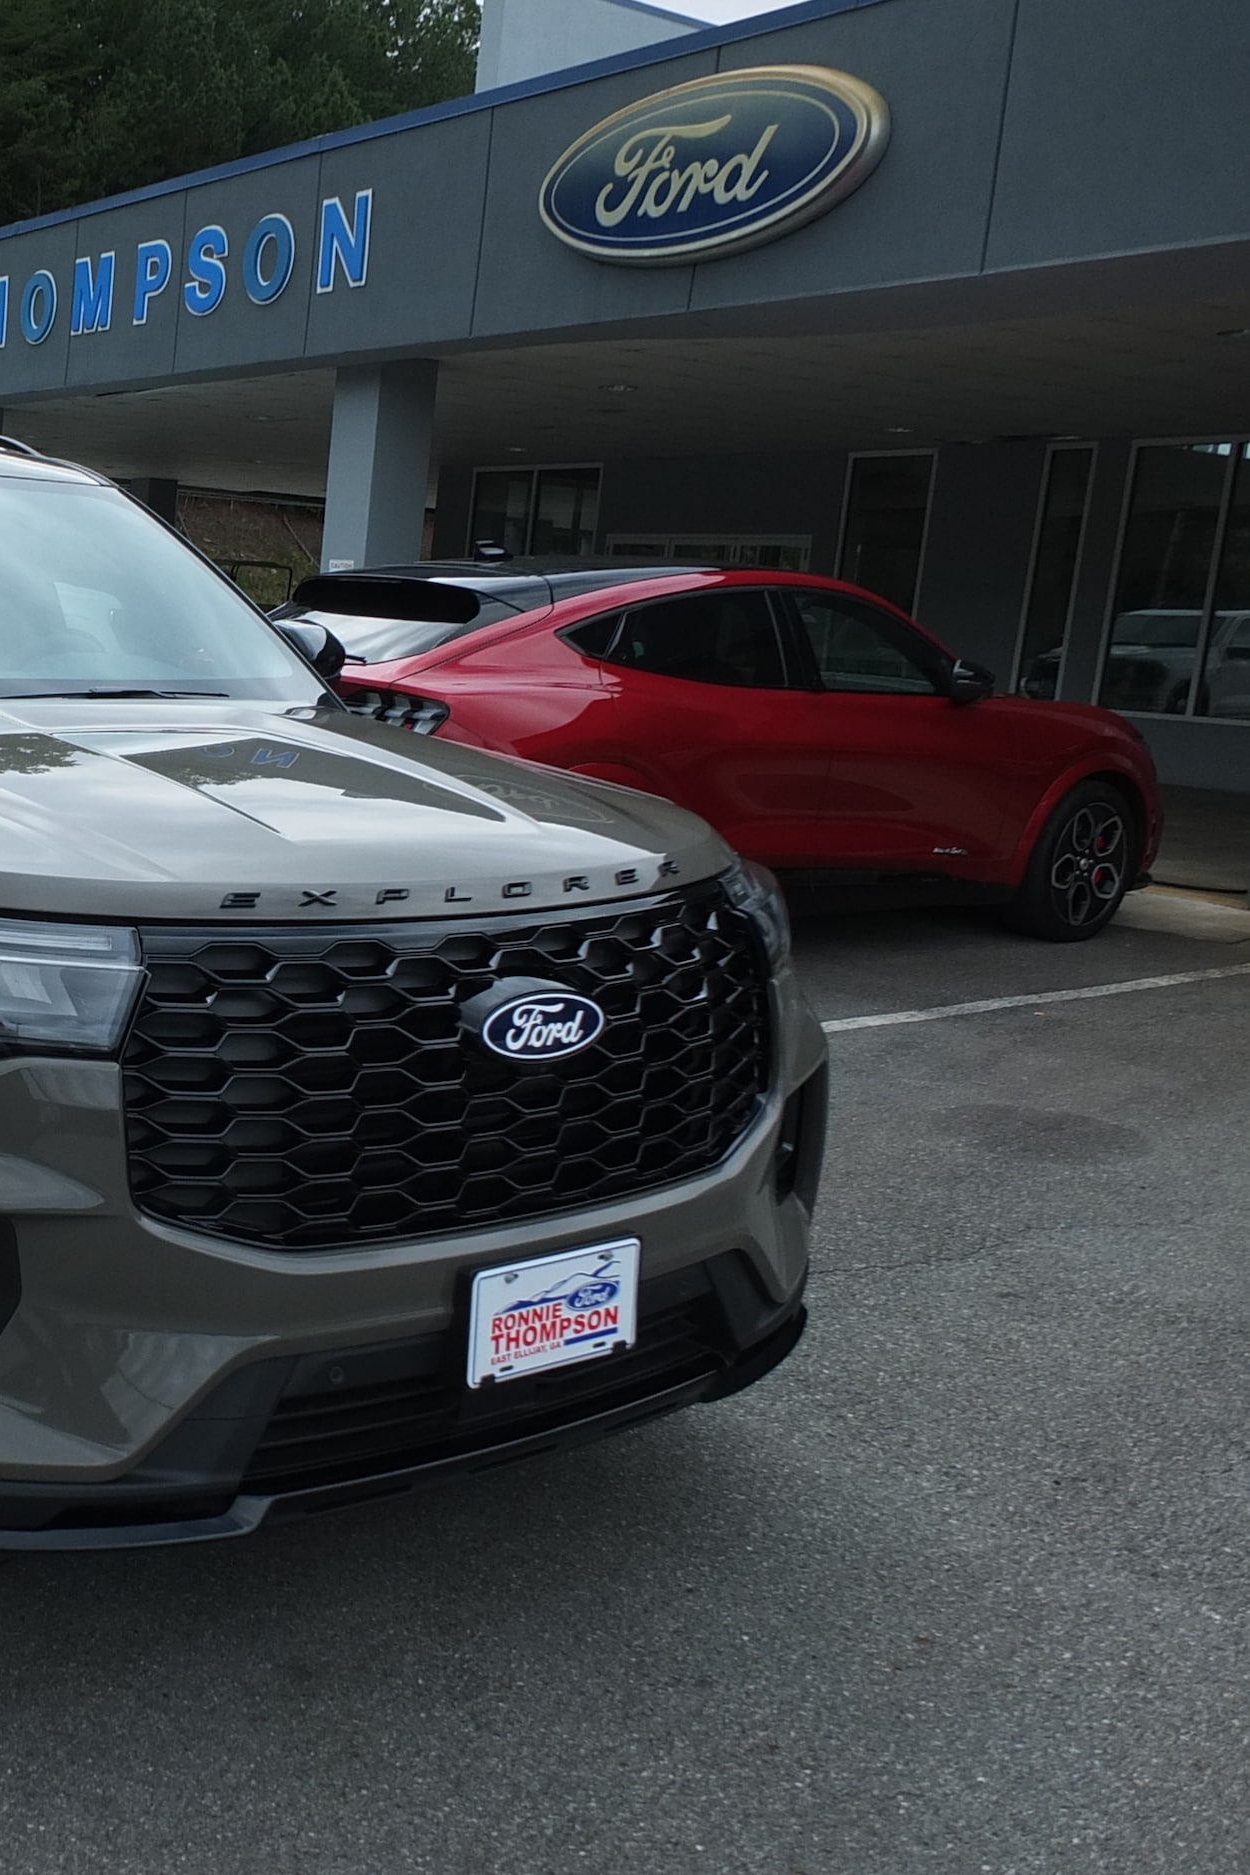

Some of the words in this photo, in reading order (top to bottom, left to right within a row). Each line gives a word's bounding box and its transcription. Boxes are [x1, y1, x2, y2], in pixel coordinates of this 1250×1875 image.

[595, 114, 779, 227] Ford
[219, 858, 682, 909] EXPLORER
[505, 1002, 585, 1051] Ford
[492, 1302, 563, 1335] RONNIE
[574, 1284, 611, 1307] Ford
[491, 1305, 619, 1355] THOMPSON
[490, 1353, 512, 1366] EAST
